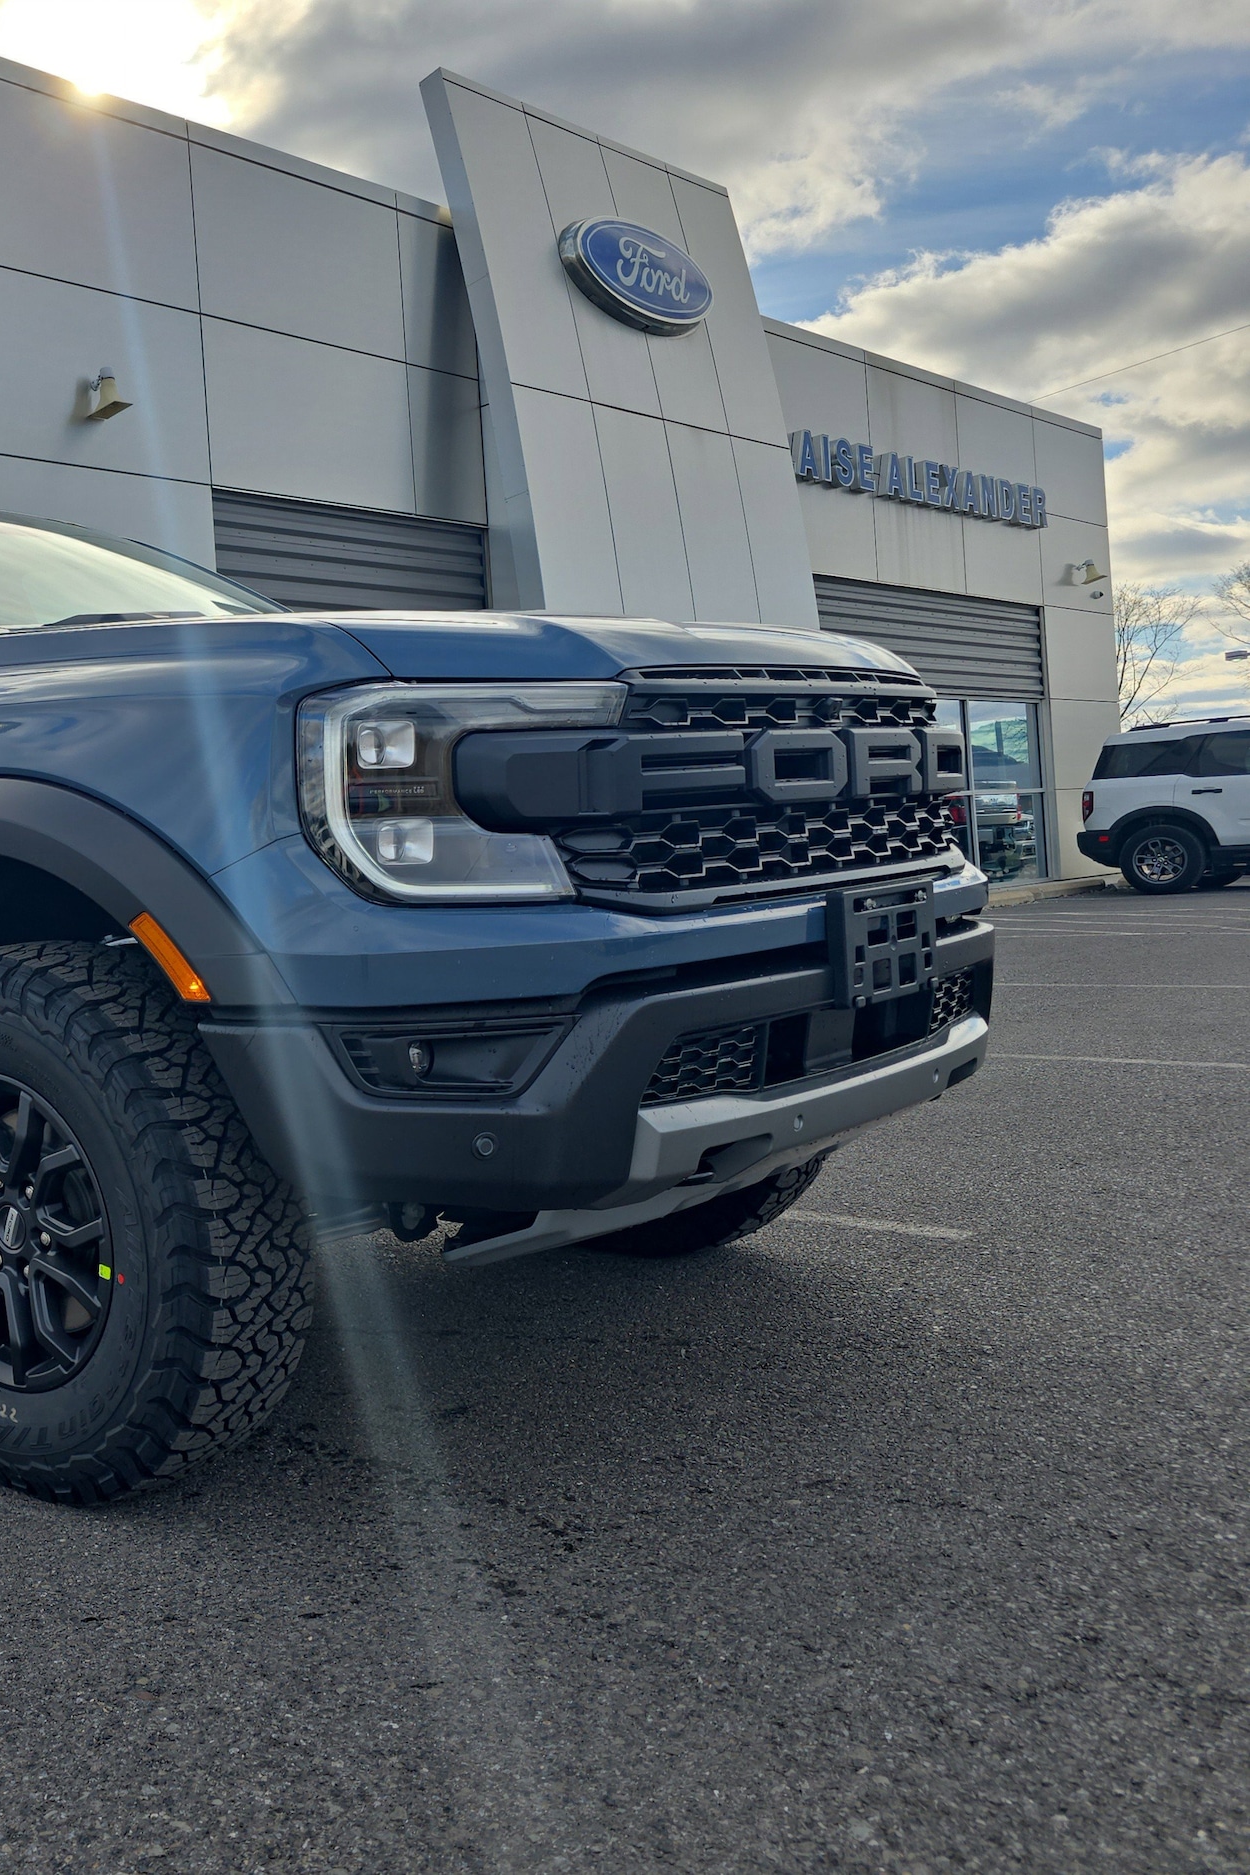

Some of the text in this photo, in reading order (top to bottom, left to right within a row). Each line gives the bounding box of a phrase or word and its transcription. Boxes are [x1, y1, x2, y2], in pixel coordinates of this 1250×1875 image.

[616, 236, 690, 304] Ford
[792, 429, 1048, 528] AISE ALEXANDER
[608, 726, 964, 817] FORD
